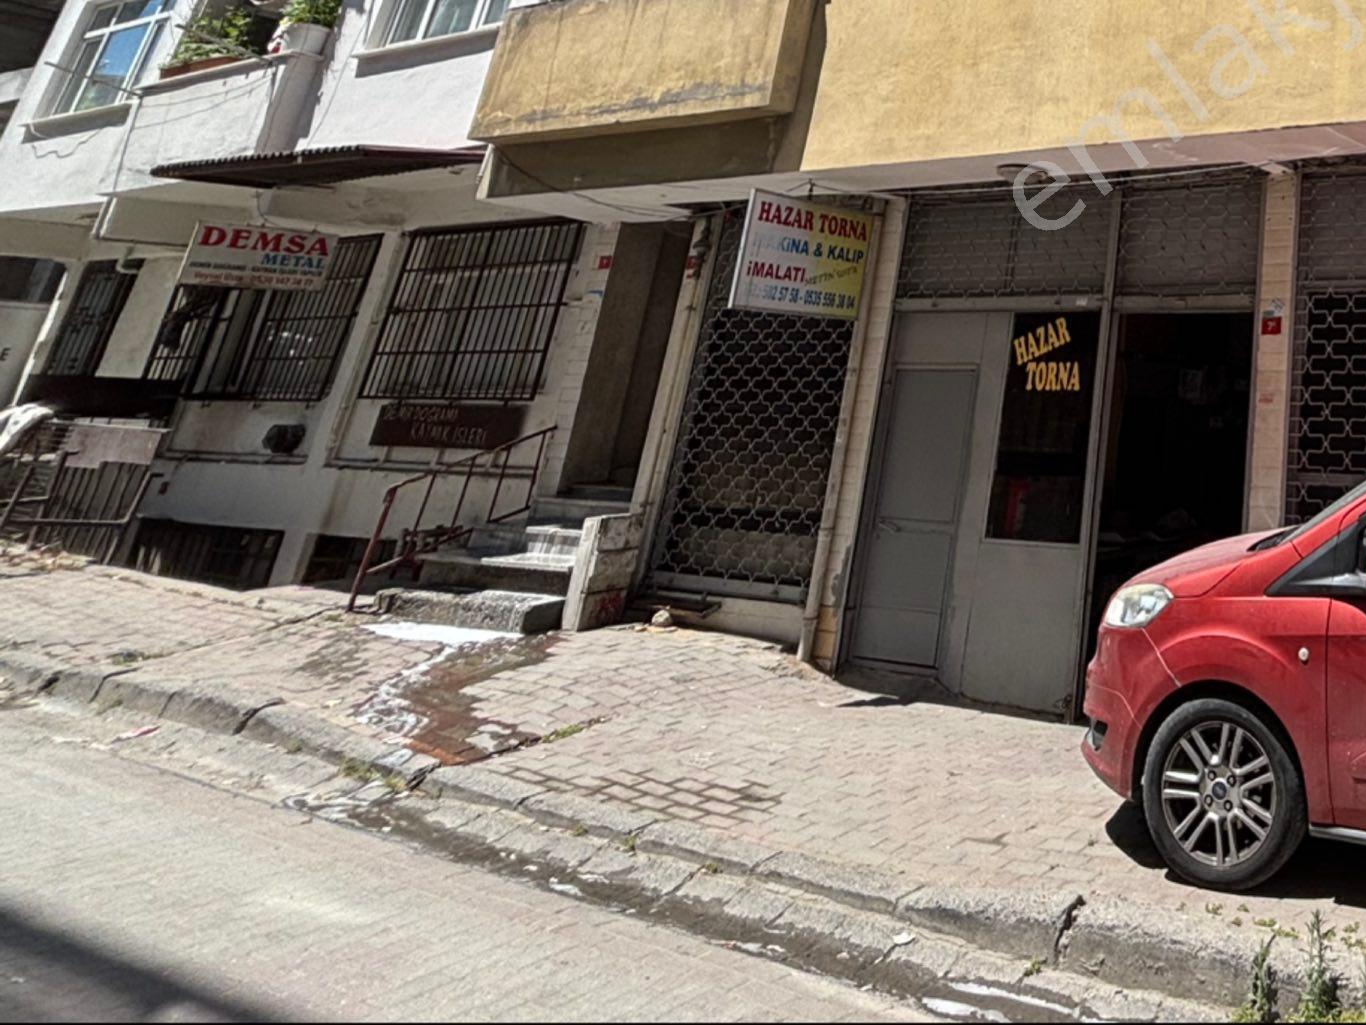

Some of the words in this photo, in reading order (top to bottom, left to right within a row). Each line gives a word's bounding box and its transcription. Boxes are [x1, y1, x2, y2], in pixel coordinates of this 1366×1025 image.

[758, 201, 814, 231] HAZAR
[819, 213, 867, 241] TORNA
[198, 226, 329, 256] DEMSA
[813, 242, 823, 257] &
[261, 253, 326, 269] METAL
[1013, 317, 1071, 366] HAZAR
[1025, 361, 1080, 391] TORNA
